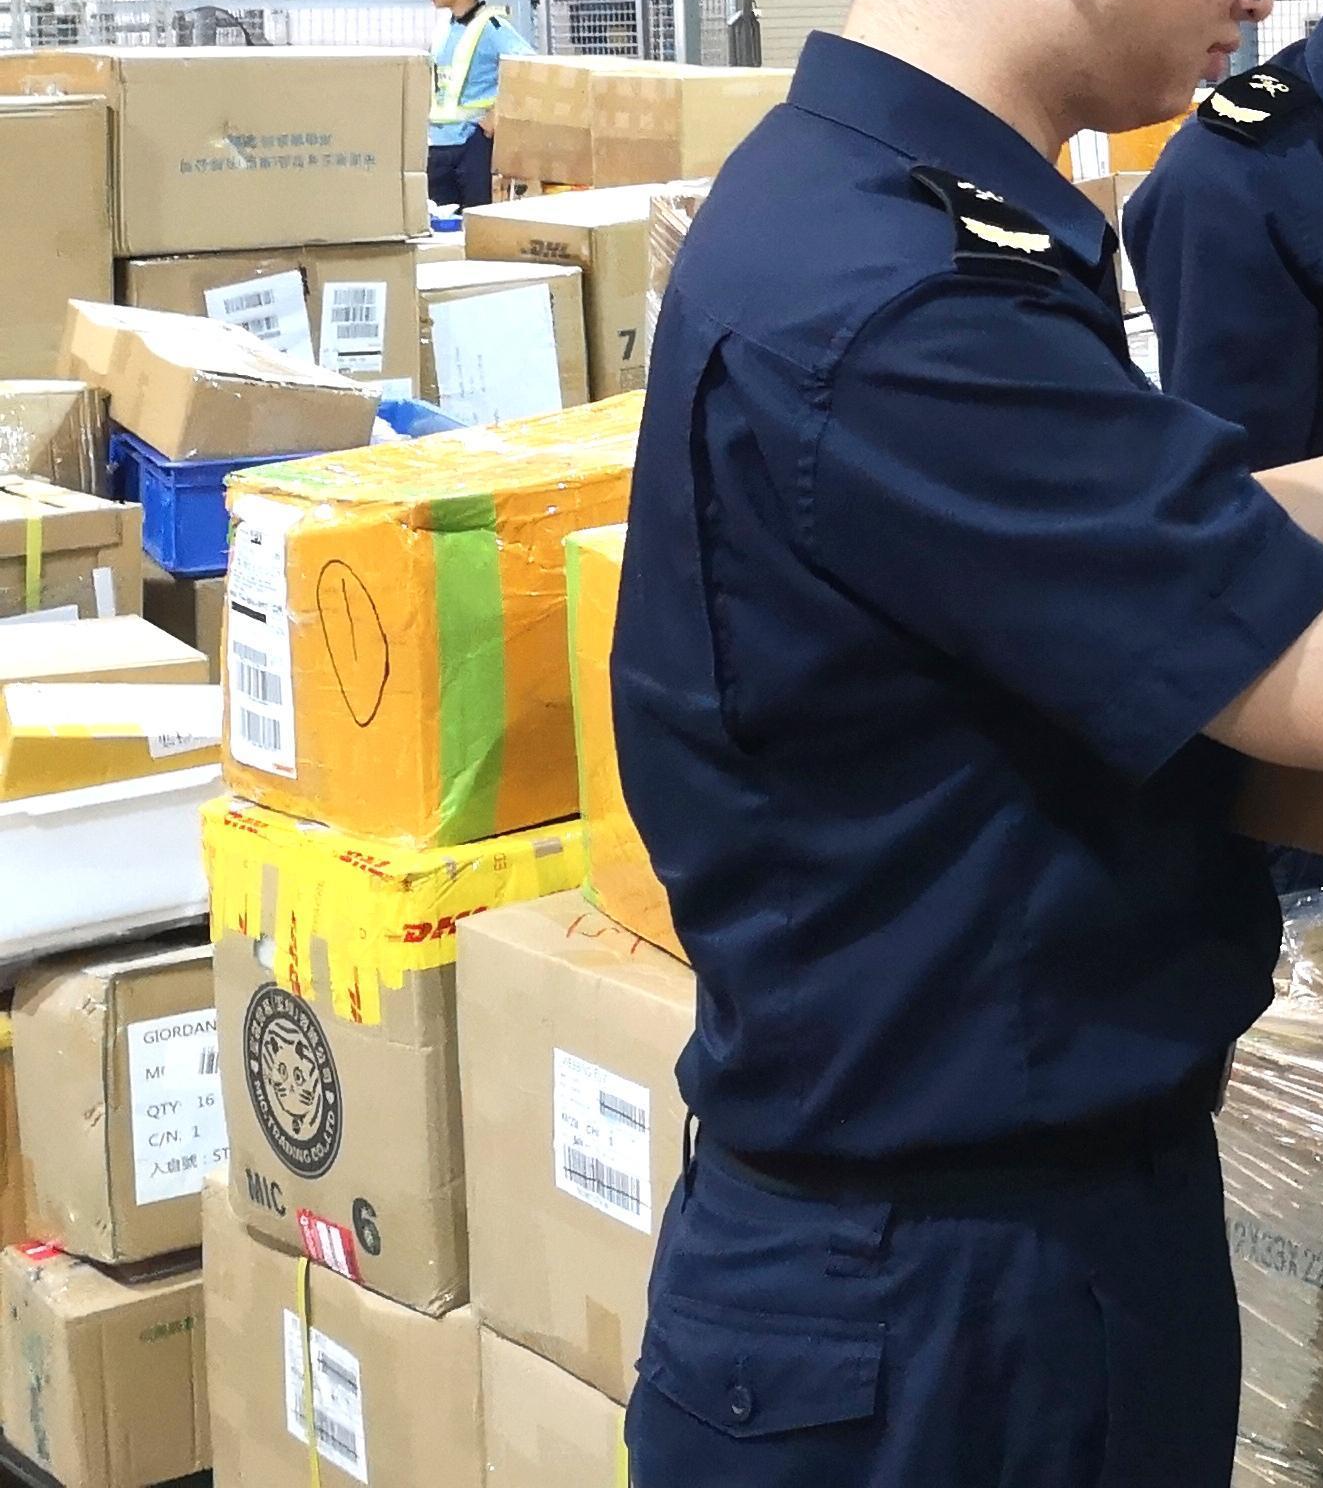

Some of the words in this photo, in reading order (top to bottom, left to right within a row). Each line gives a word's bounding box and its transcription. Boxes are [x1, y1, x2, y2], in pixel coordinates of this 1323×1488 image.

[617, 328, 637, 361] 7
[246, 1168, 286, 1216] MIC
[352, 1197, 381, 1256] 6
